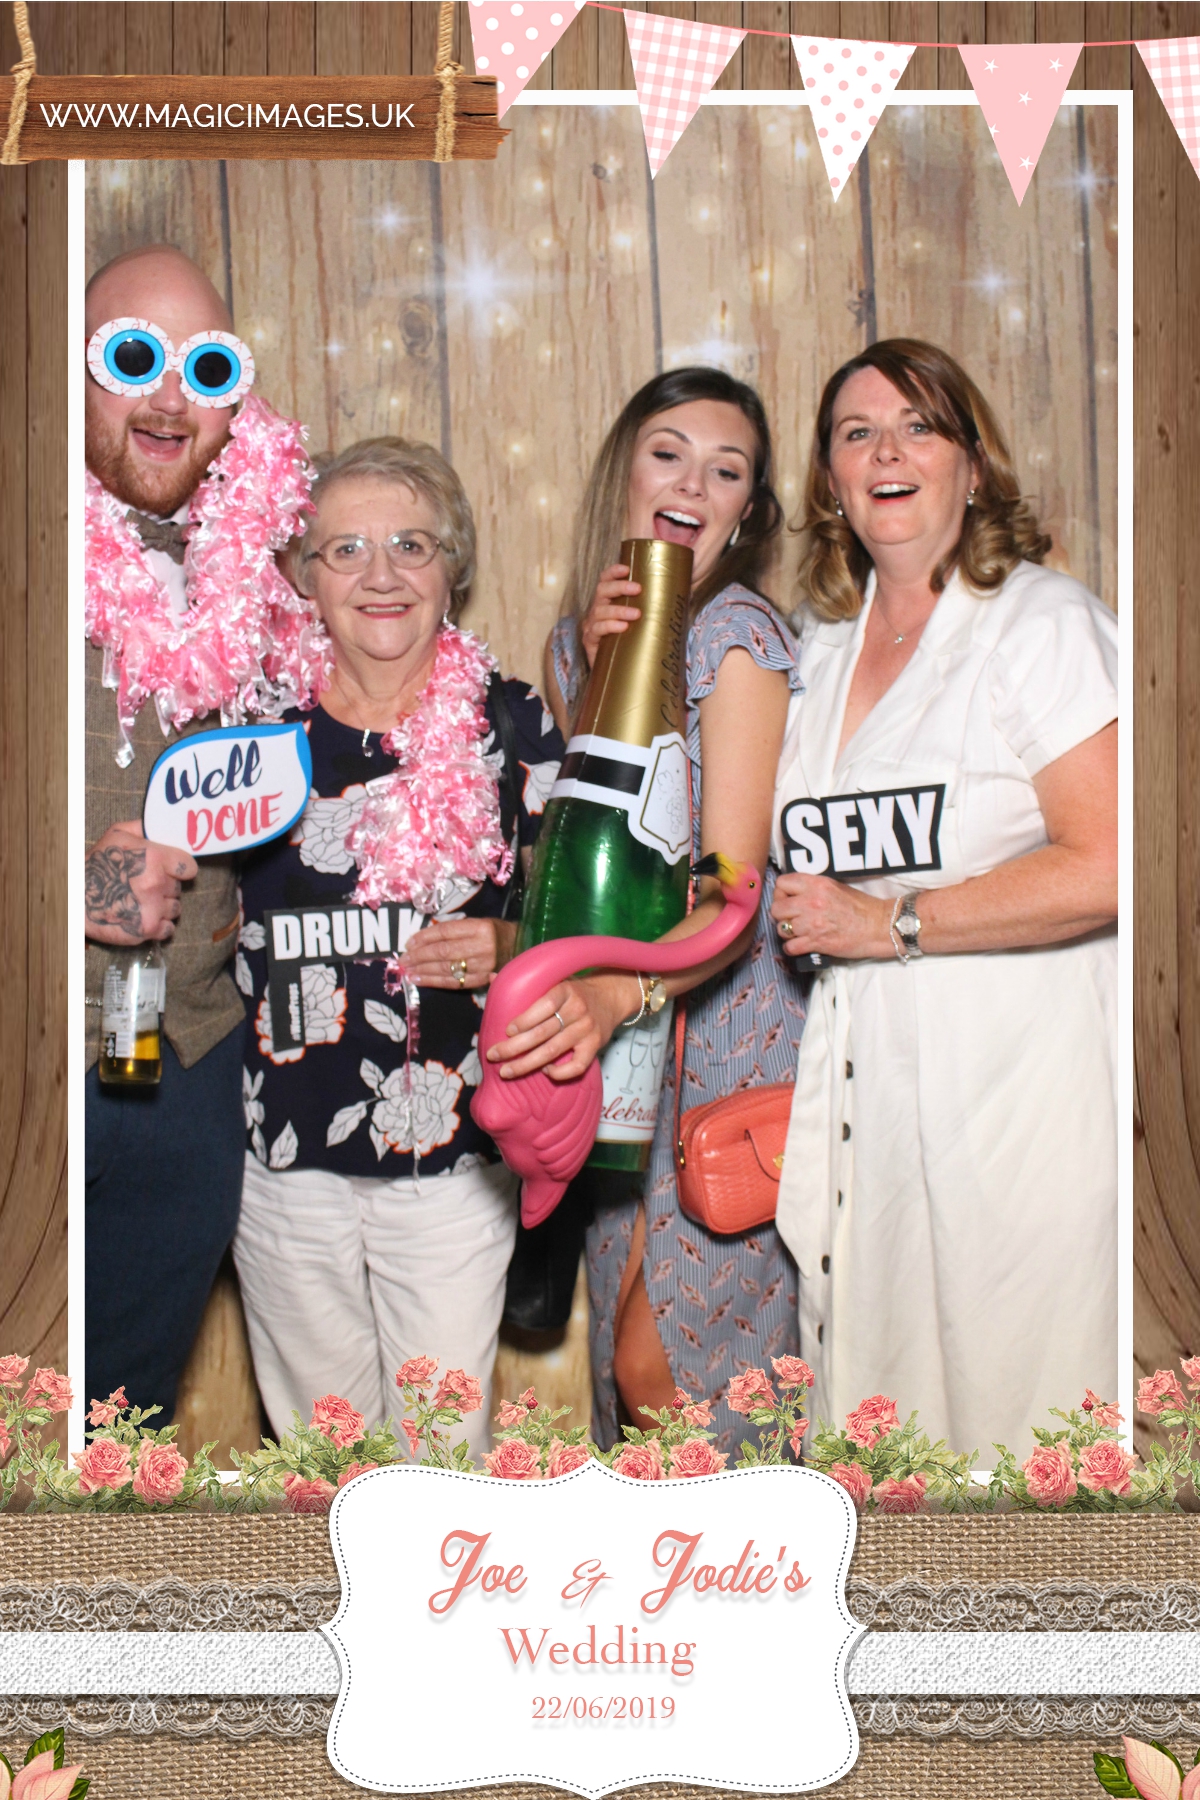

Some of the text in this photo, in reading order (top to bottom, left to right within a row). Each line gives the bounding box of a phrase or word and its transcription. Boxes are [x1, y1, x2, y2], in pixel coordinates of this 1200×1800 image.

[660, 593, 684, 729] Celebration
[165, 739, 263, 805] Well
[785, 791, 937, 875] SEXY
[271, 907, 425, 961] DRUNK
